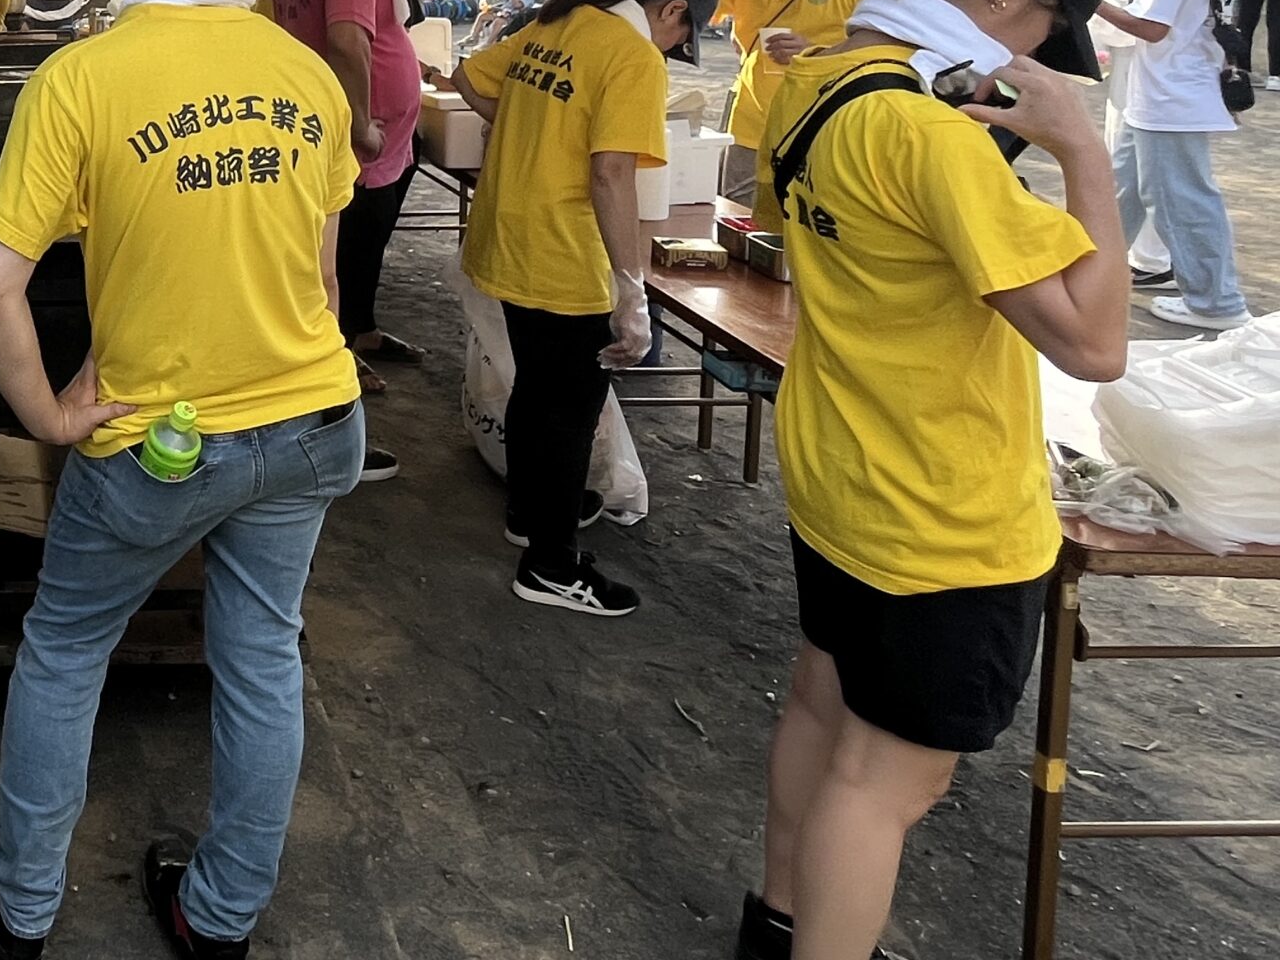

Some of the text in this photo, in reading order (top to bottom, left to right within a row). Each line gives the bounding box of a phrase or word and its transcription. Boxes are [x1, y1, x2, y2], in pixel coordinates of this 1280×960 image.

[127, 94, 324, 163] 川崎北工業会
